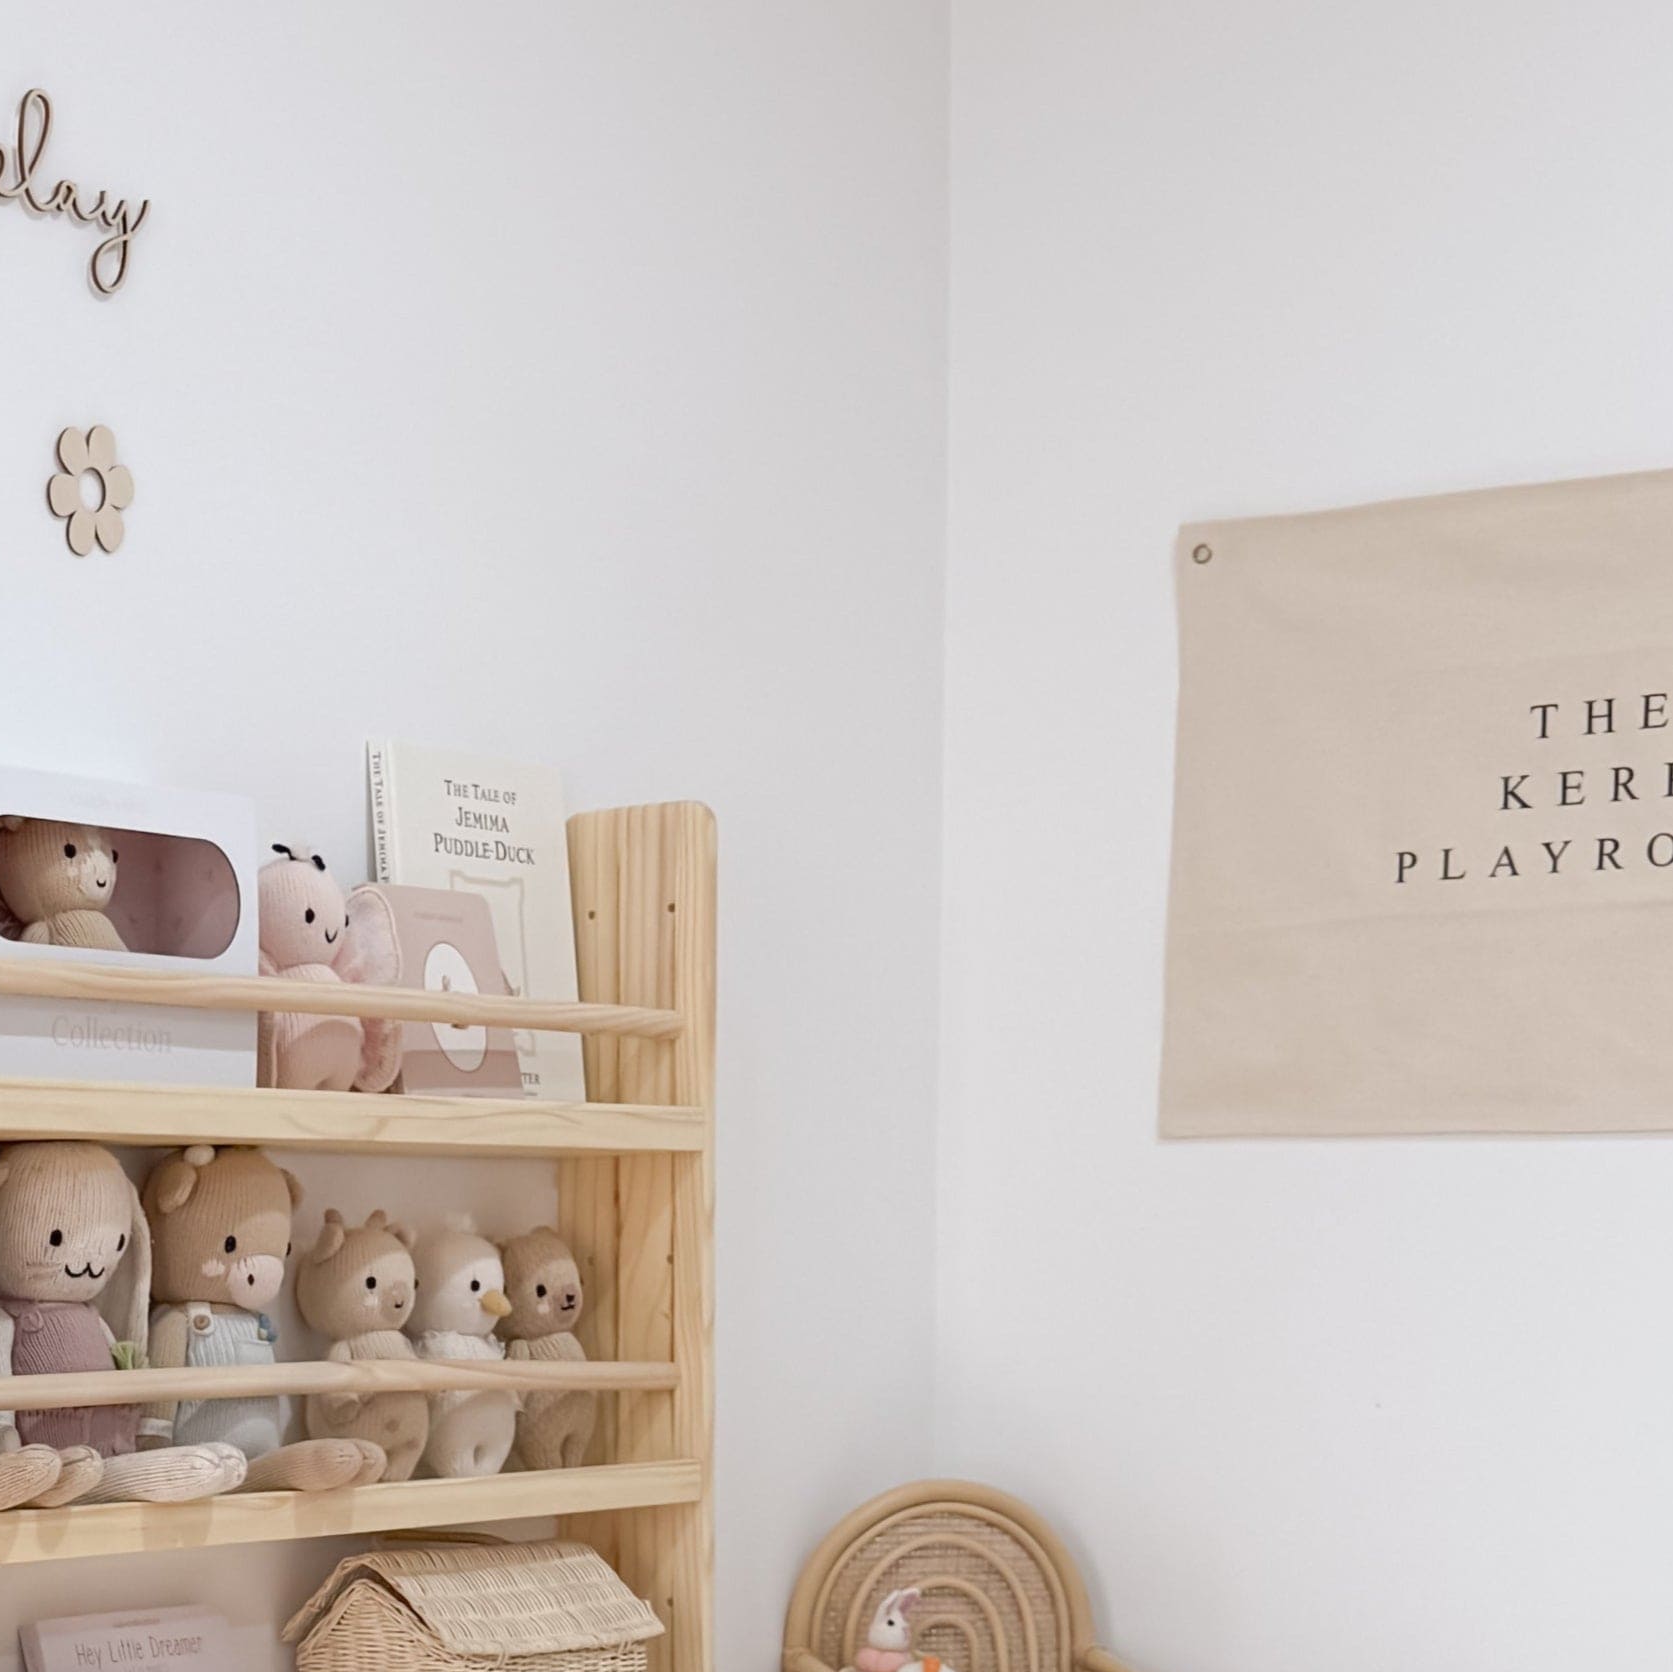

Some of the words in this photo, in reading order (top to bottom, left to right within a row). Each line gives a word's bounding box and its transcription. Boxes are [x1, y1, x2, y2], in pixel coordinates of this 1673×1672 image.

[1529, 693, 1669, 739] THE
[443, 779, 469, 799] THE
[471, 783, 500, 803] TALE
[502, 791, 517, 806] OF
[455, 806, 510, 833] JEMIMA
[433, 832, 536, 865] PUDDLE-DUCK
[51, 1014, 172, 1053] Collection
[74, 1641, 103, 1670] Hey
[107, 1638, 145, 1663] Little
[148, 1635, 203, 1658] Dreamer
